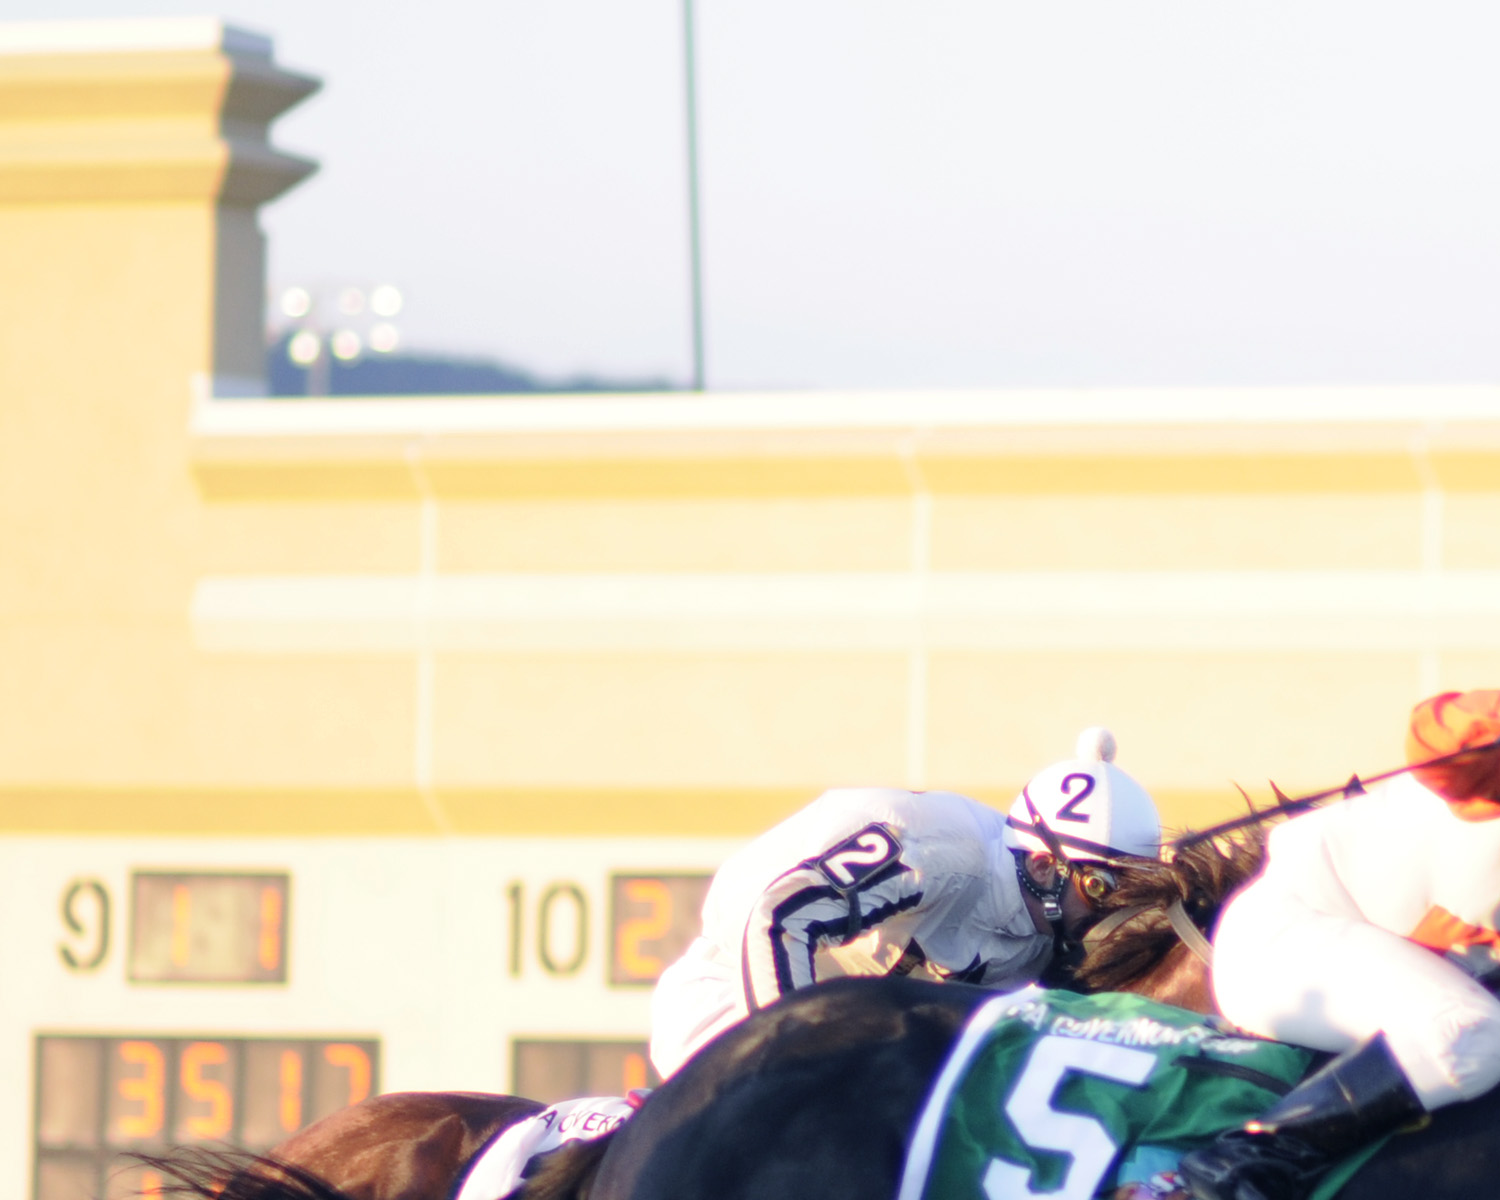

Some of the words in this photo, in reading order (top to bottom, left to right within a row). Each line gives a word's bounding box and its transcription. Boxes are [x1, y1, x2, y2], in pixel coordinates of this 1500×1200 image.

[1055, 772, 1096, 824] 2
[822, 831, 891, 886] 2
[60, 878, 111, 971] 9
[507, 881, 591, 977] 10
